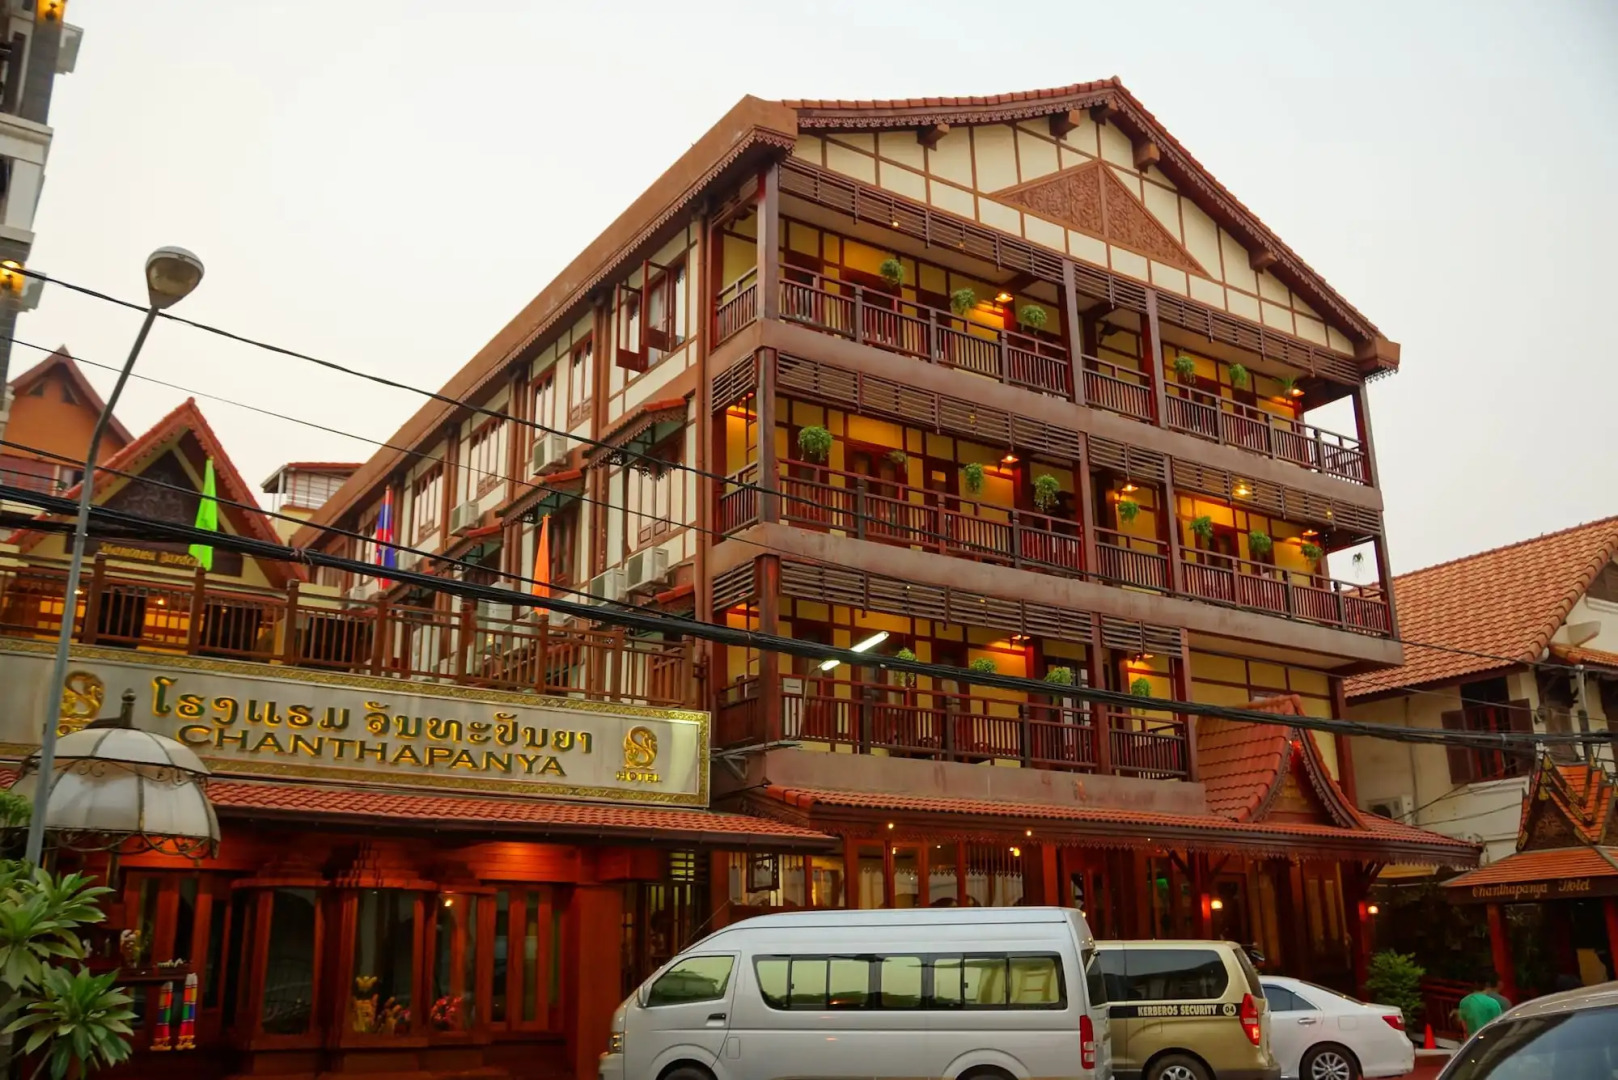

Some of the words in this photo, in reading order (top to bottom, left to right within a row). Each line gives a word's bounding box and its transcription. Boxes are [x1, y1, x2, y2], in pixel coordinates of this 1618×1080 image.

[176, 724, 567, 777] CHANTHAPANYA
[615, 770, 663, 784] HOTEL
[1137, 1005, 1178, 1017] KERBEROS
[1180, 1004, 1218, 1016] SECURITY
